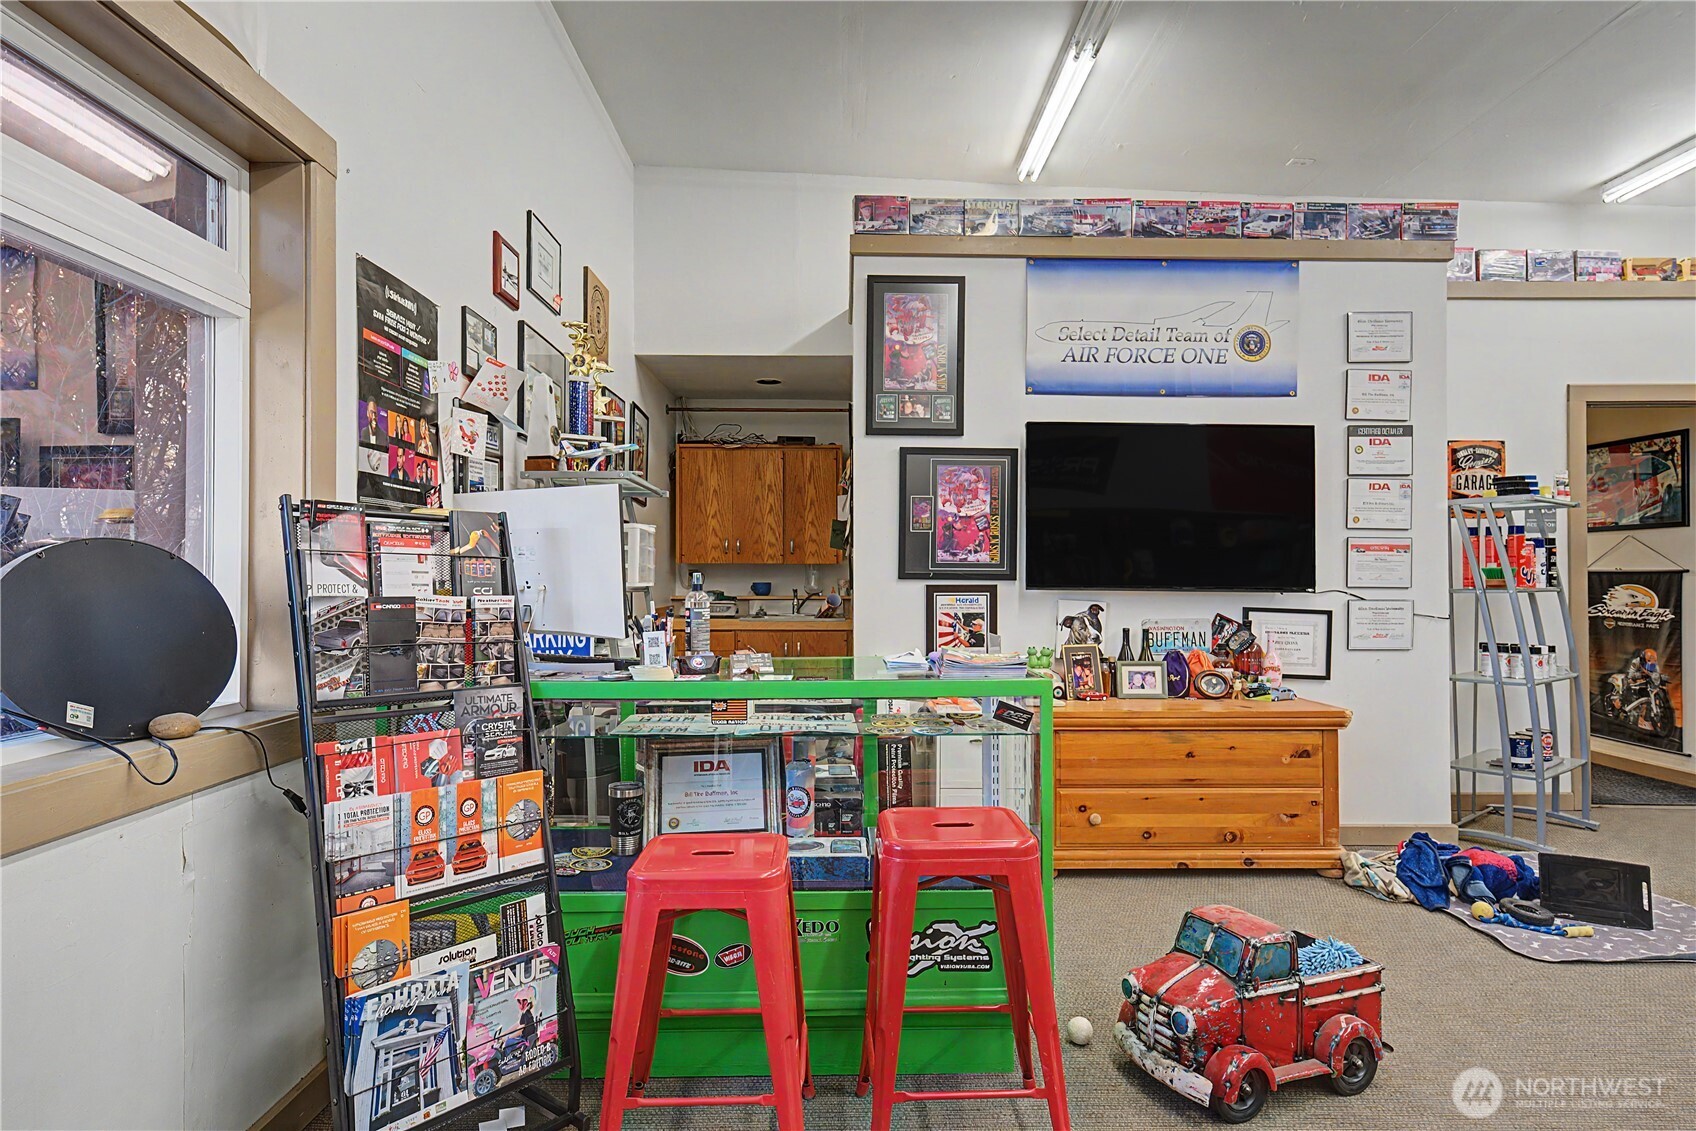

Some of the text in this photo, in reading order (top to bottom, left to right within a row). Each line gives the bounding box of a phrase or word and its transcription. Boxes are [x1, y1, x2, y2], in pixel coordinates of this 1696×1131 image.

[1058, 326, 1233, 345] Select Detail Team of
[1061, 347, 1228, 364] AIR FORCE ONE
[1368, 374, 1390, 382] IDA
[1369, 438, 1391, 446] IDA
[1369, 483, 1391, 491] IDA
[317, 583, 358, 594] PROTECT &
[955, 596, 979, 604] Herald
[1639, 608, 1669, 622] Eagle
[524, 634, 586, 648] ARKING
[1149, 631, 1206, 648] BUFFMAN
[465, 693, 513, 706] ULTIMATE
[461, 701, 517, 718] ARMOUR
[693, 760, 731, 773] IDA
[344, 810, 359, 819] TOTAL
[464, 803, 475, 813] GP
[417, 811, 431, 822] GP
[535, 914, 544, 947] solutio
[565, 926, 596, 938] OUGH
[796, 918, 840, 937] XEDO
[566, 932, 613, 946] OUNTRY
[438, 946, 478, 966] solution
[910, 954, 990, 962] ghting Systems
[475, 957, 551, 999] VENUE
